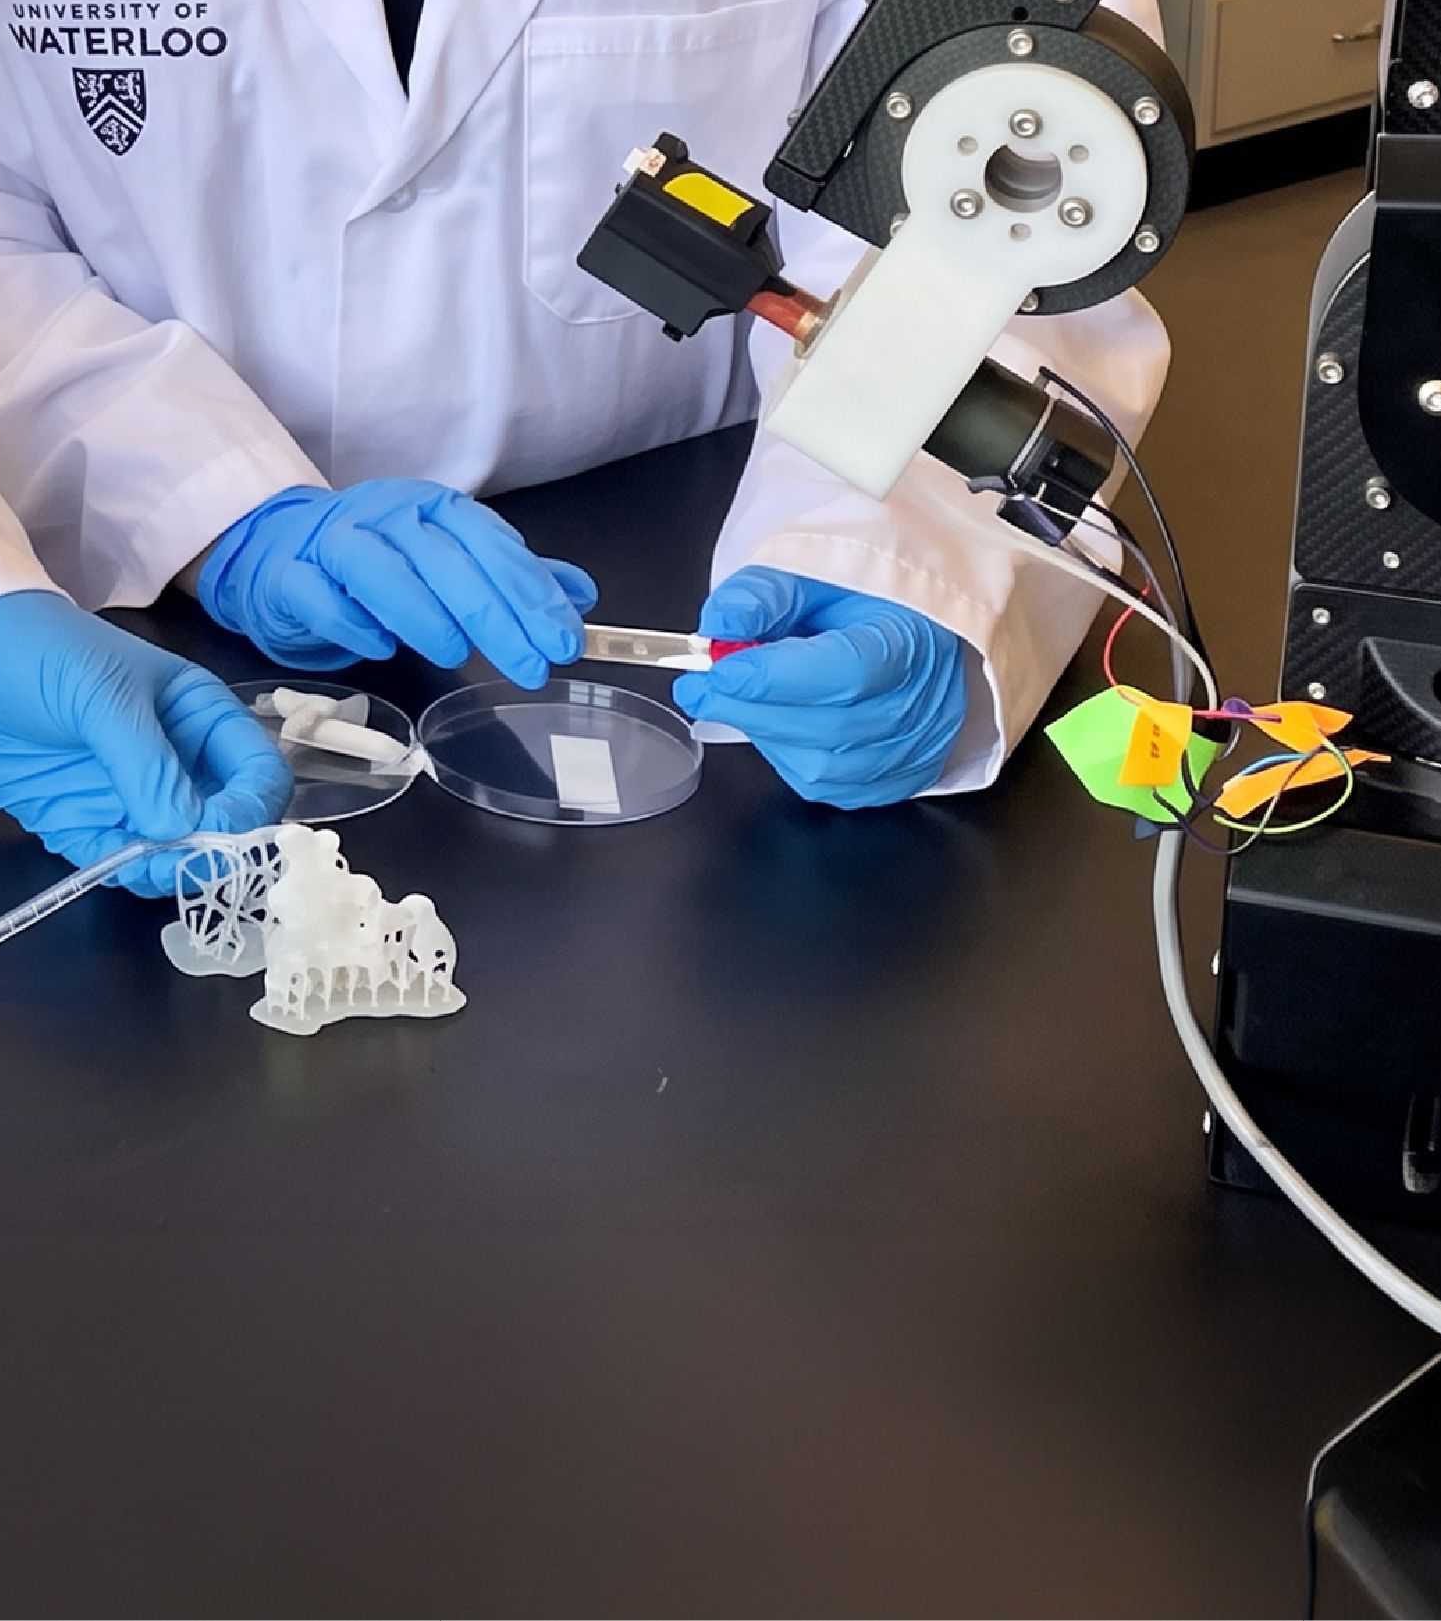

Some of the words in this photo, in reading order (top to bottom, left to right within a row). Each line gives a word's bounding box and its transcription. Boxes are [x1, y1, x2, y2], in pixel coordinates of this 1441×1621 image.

[13, 3, 161, 19] UNIVERSITY
[175, 3, 208, 19] OF
[8, 23, 227, 57] WATERLOO
